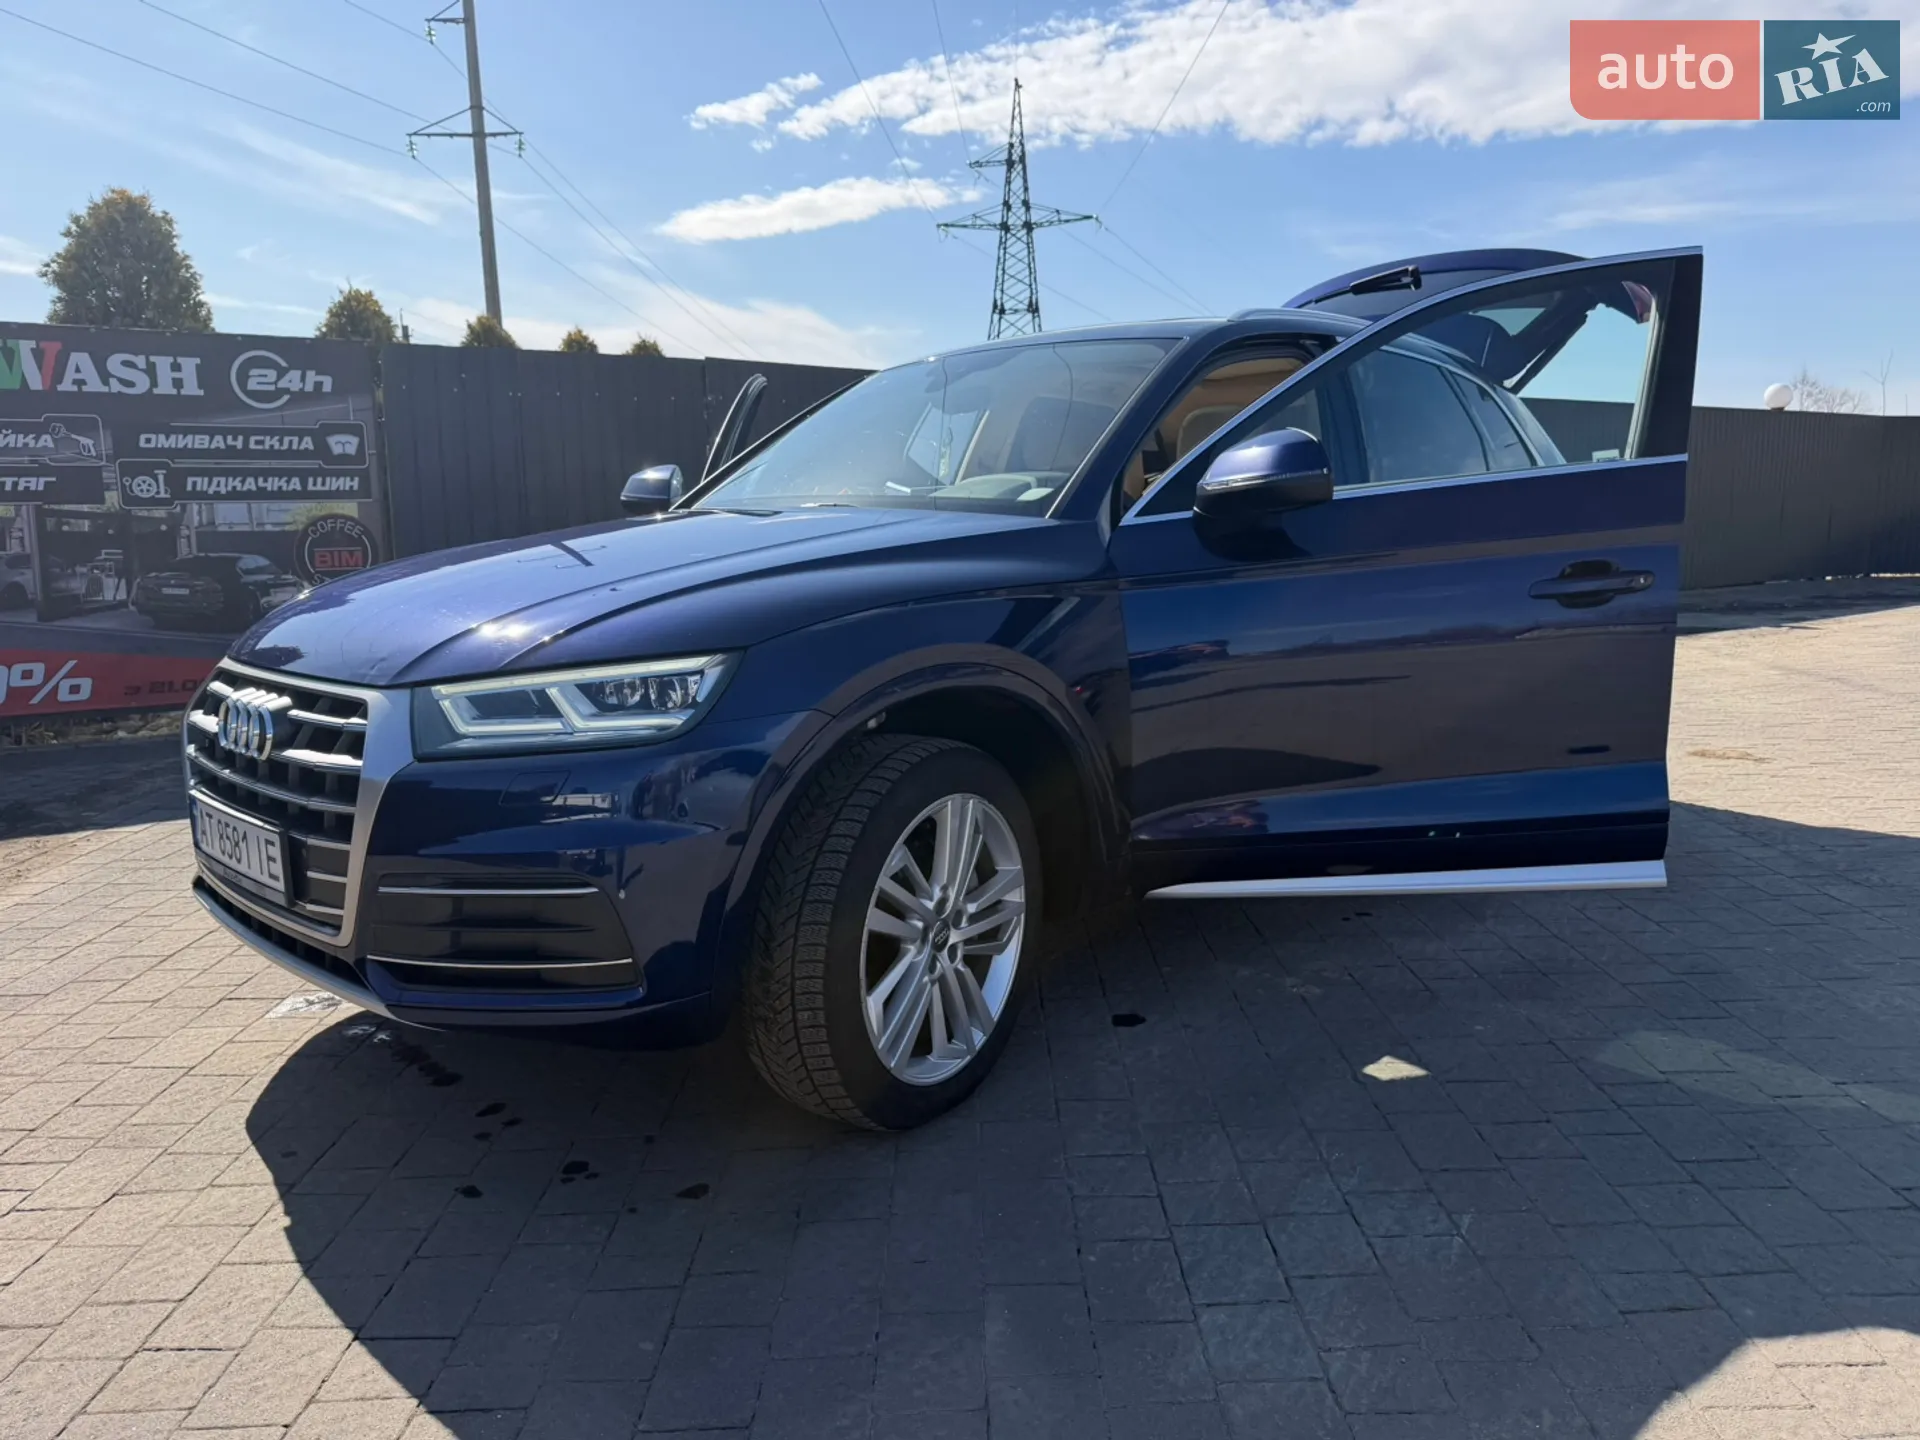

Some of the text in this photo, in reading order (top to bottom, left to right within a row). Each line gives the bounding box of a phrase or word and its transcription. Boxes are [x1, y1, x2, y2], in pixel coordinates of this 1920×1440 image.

[246, 367, 333, 393] 24h
[138, 433, 314, 450] ОМИВАЧ СКЛА
[186, 476, 359, 494] ПІДКАЧКА ШИН
[307, 518, 364, 538] COFFEE
[314, 550, 363, 569] BIM
[200, 807, 280, 883] AT 8581 IE
